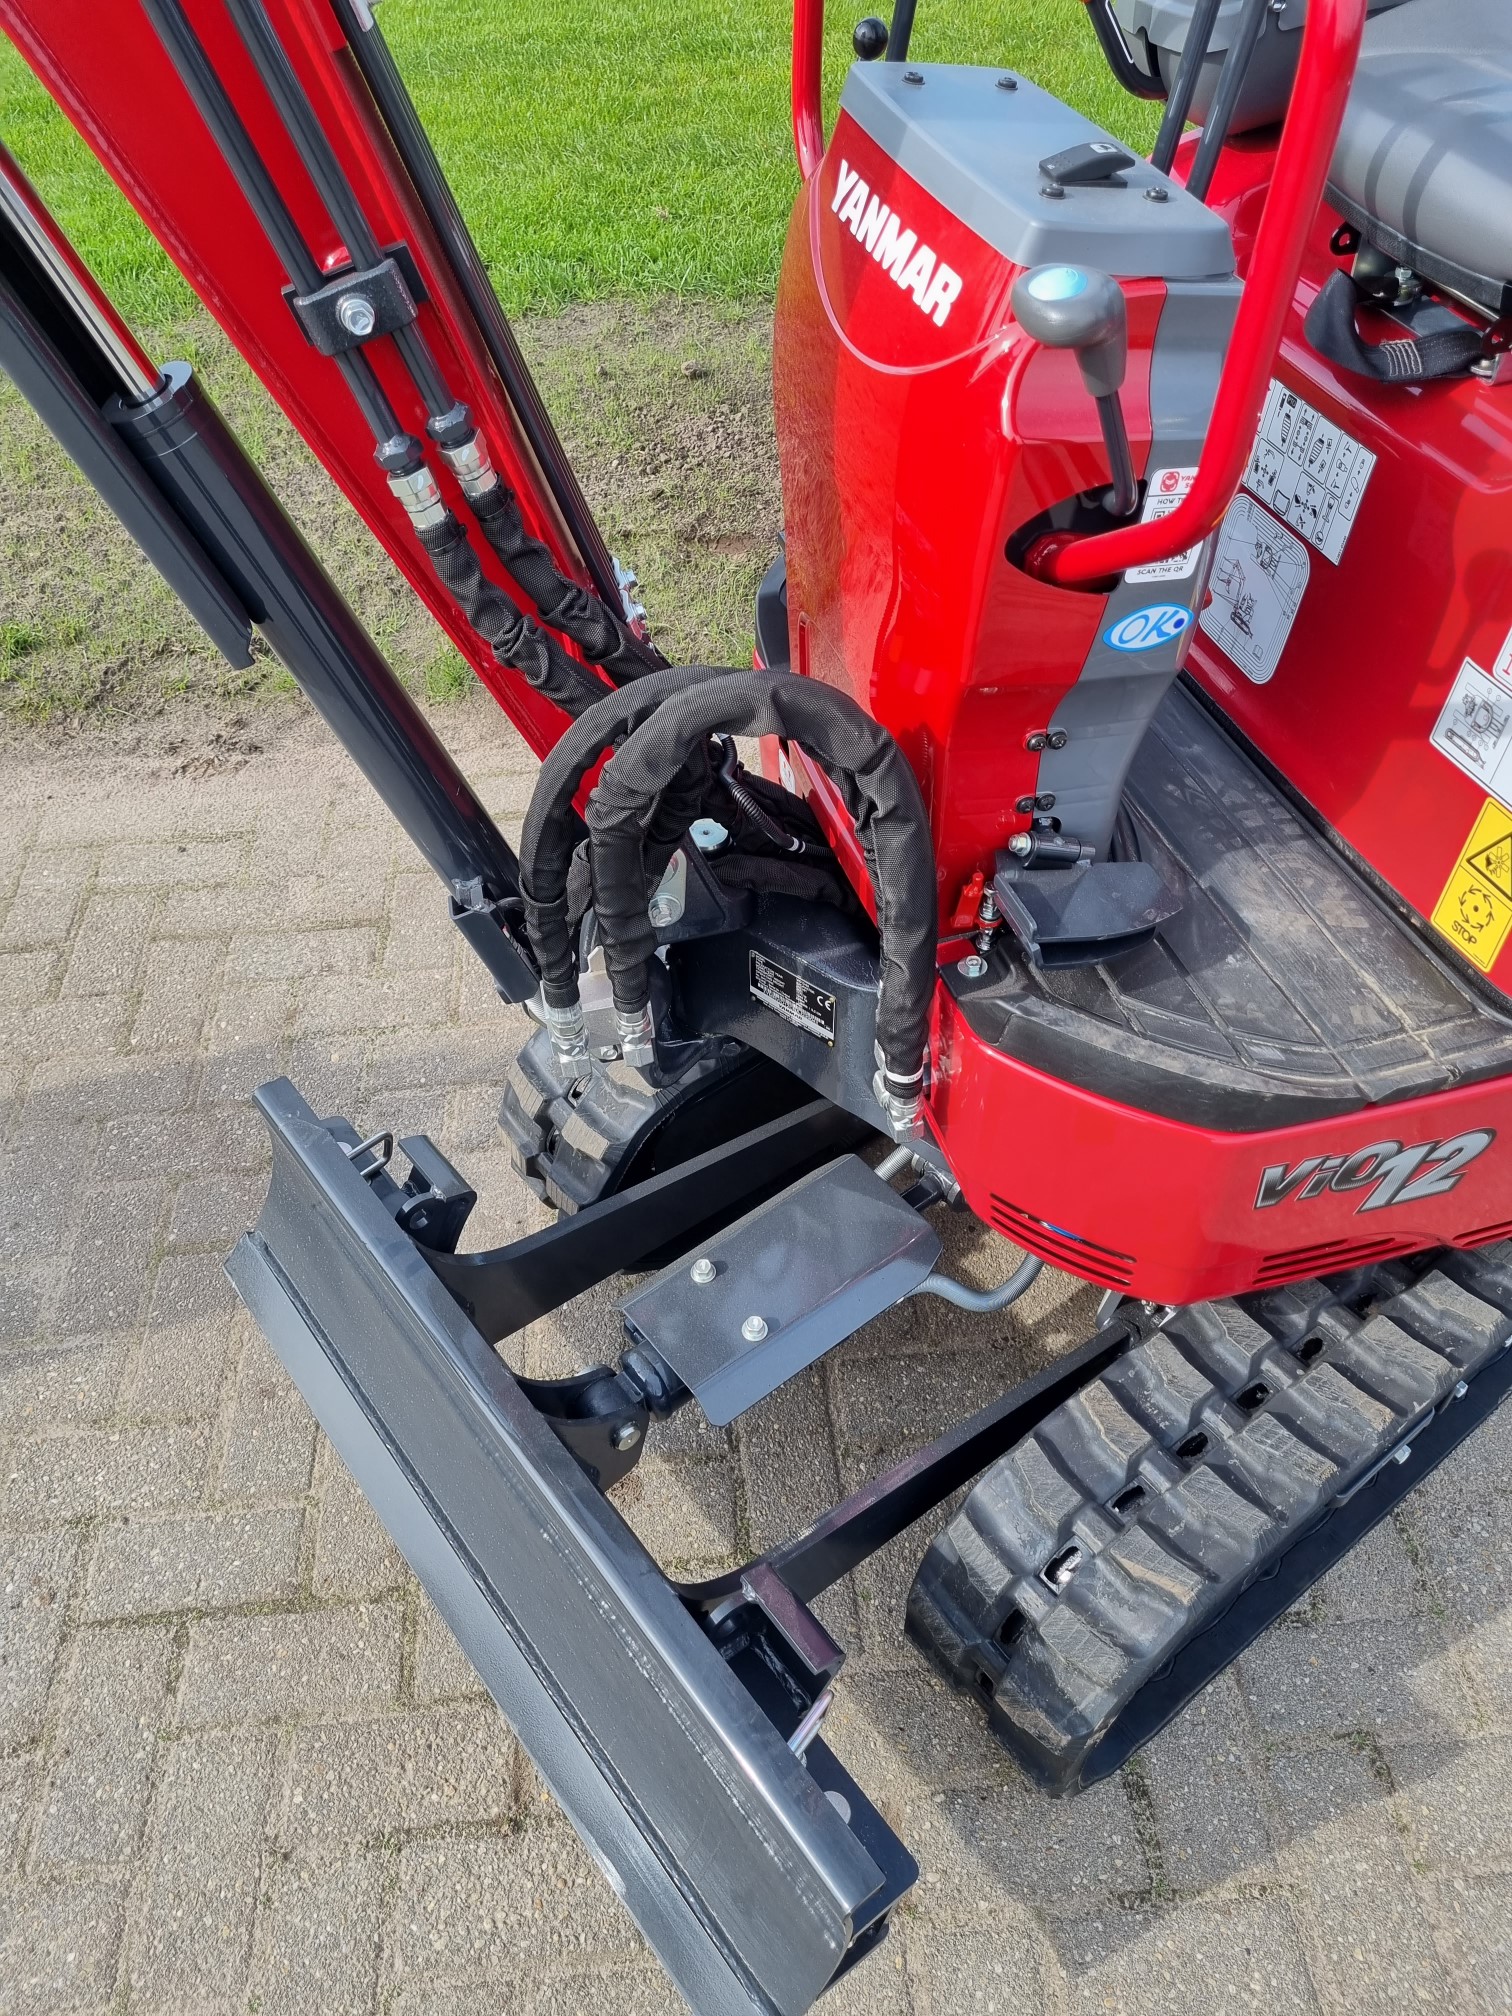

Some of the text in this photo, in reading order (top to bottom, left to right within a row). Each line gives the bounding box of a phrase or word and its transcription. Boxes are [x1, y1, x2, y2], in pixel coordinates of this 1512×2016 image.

[831, 158, 963, 328] YANMAR
[1136, 568, 1157, 576] SCAN
[1118, 609, 1180, 645] OK
[1451, 919, 1478, 945] STOP
